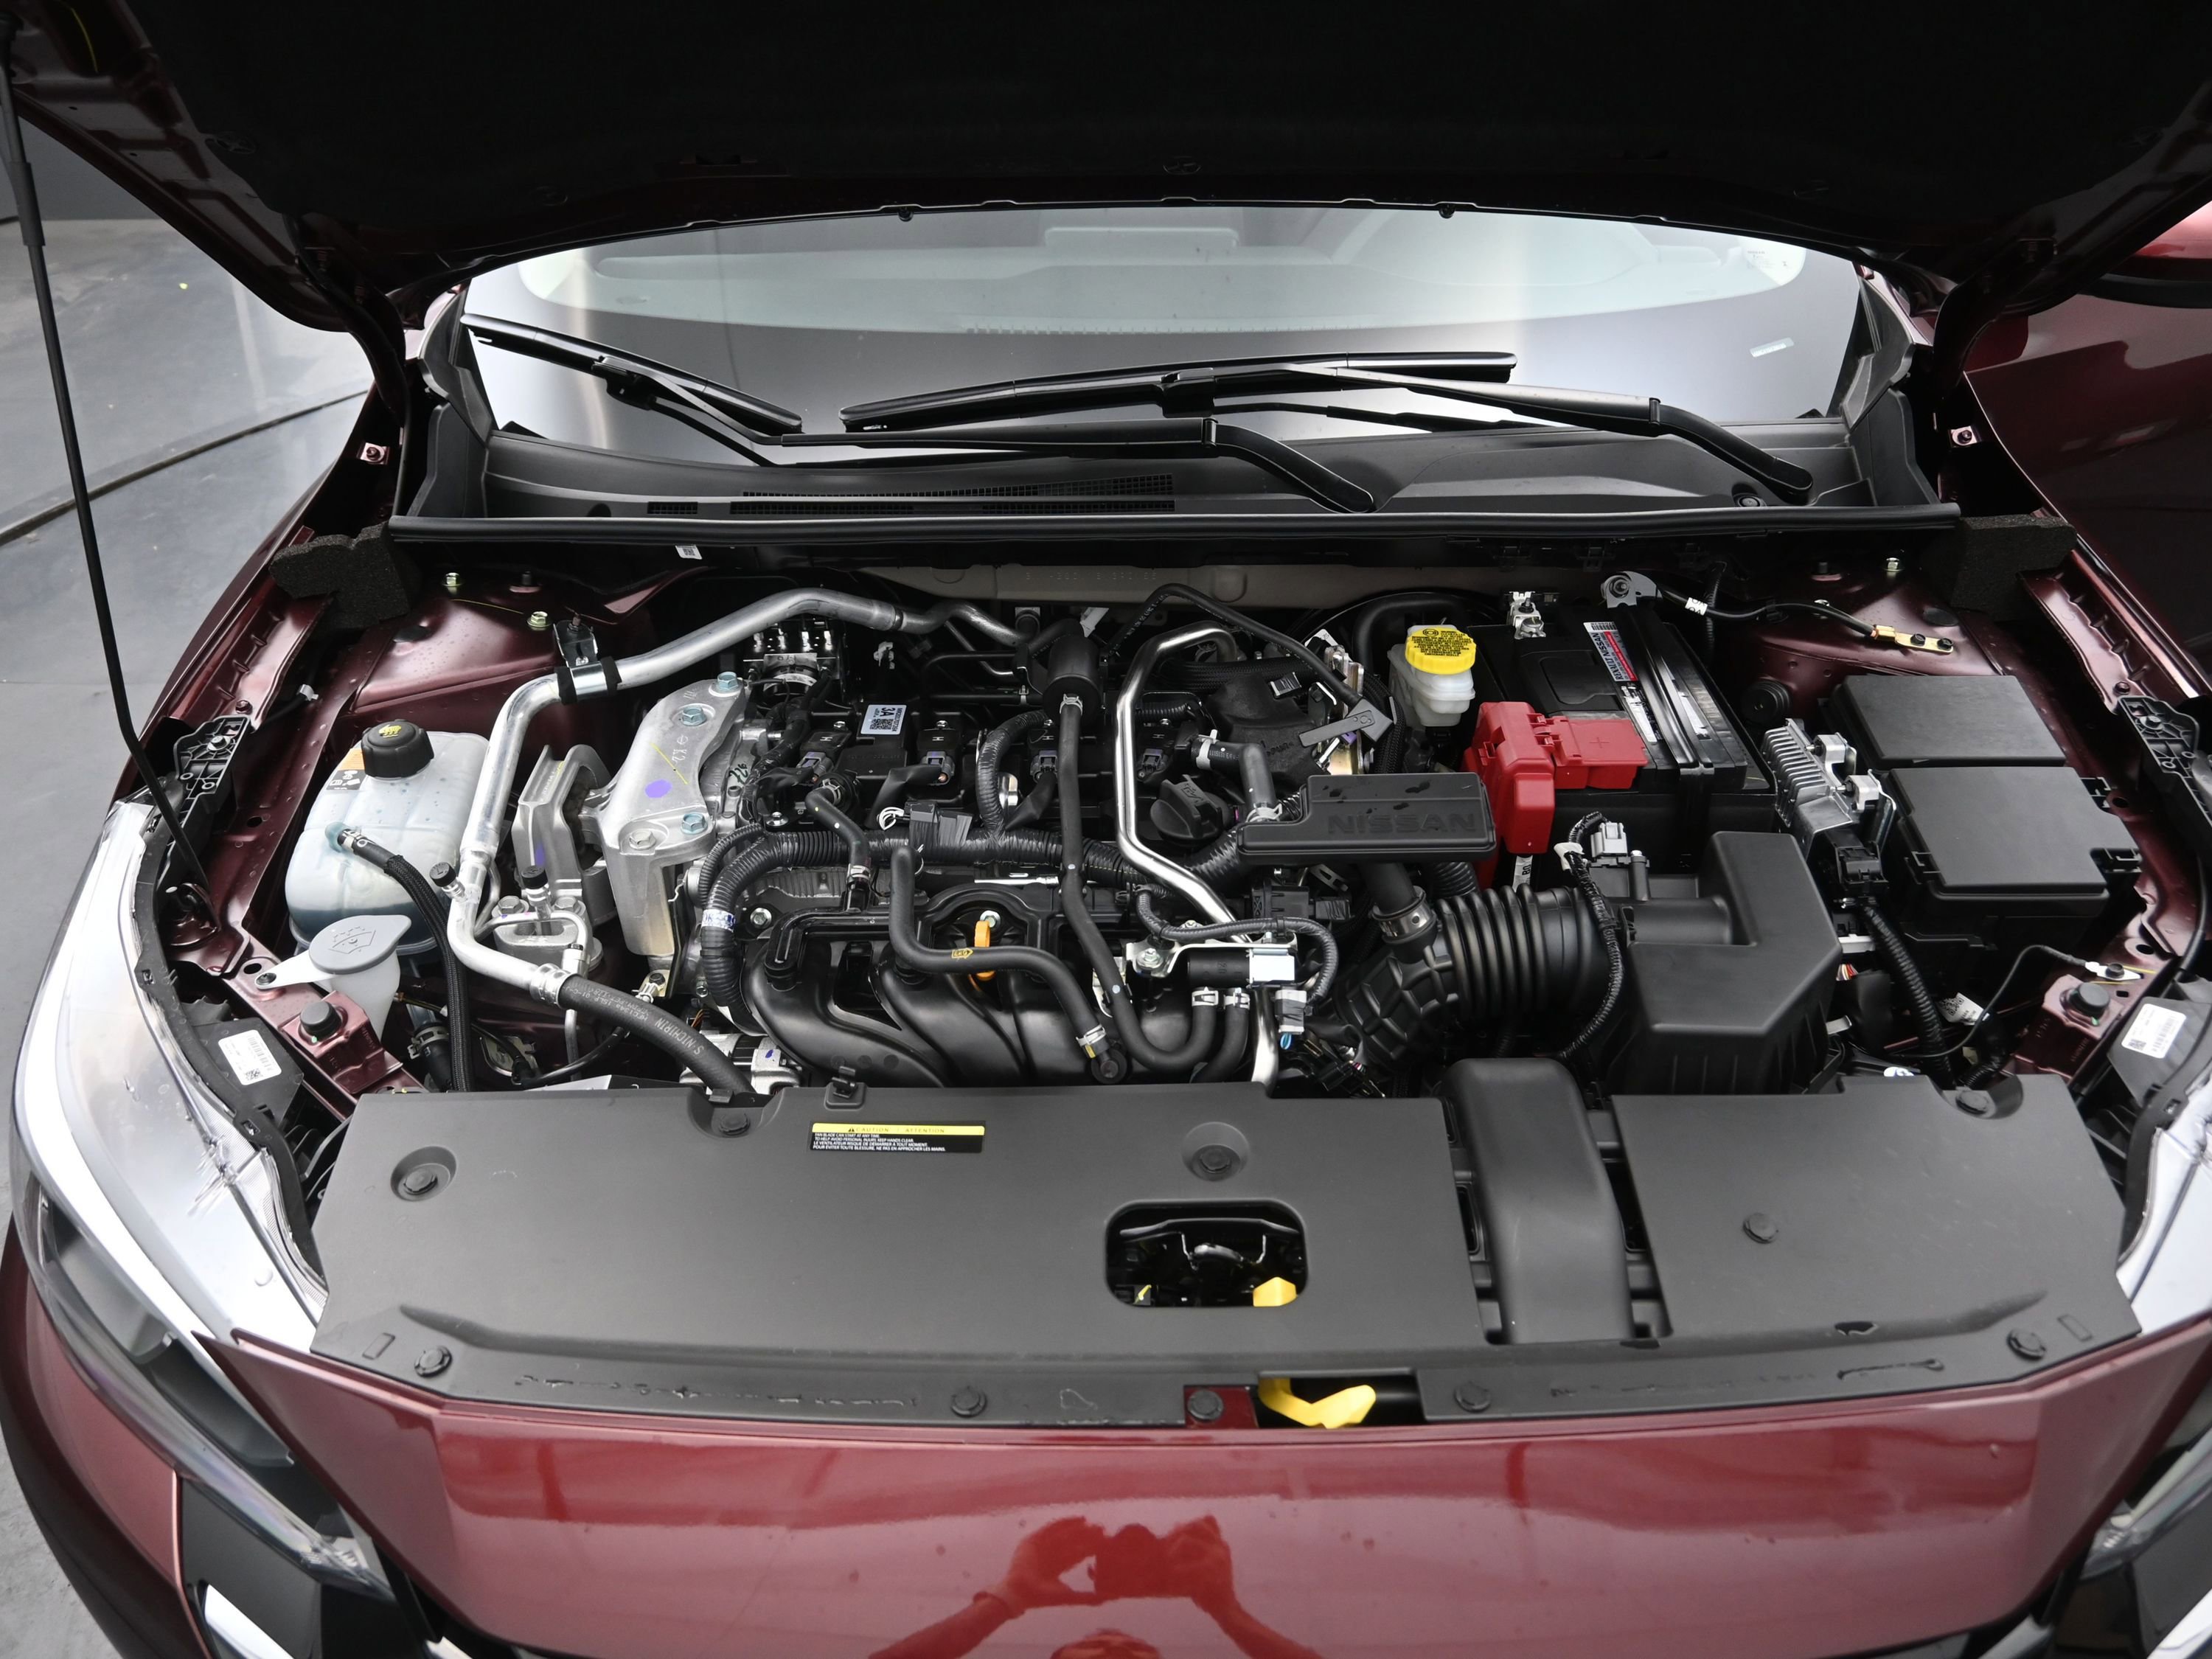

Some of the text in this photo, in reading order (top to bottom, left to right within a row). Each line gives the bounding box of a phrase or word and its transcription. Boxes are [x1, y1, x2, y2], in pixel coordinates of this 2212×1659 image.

[1591, 633, 1611, 657] NISSAN
[1604, 657, 1624, 680] RENAULT
[880, 707, 896, 717] 3A
[1328, 813, 1475, 834] NISSAN
